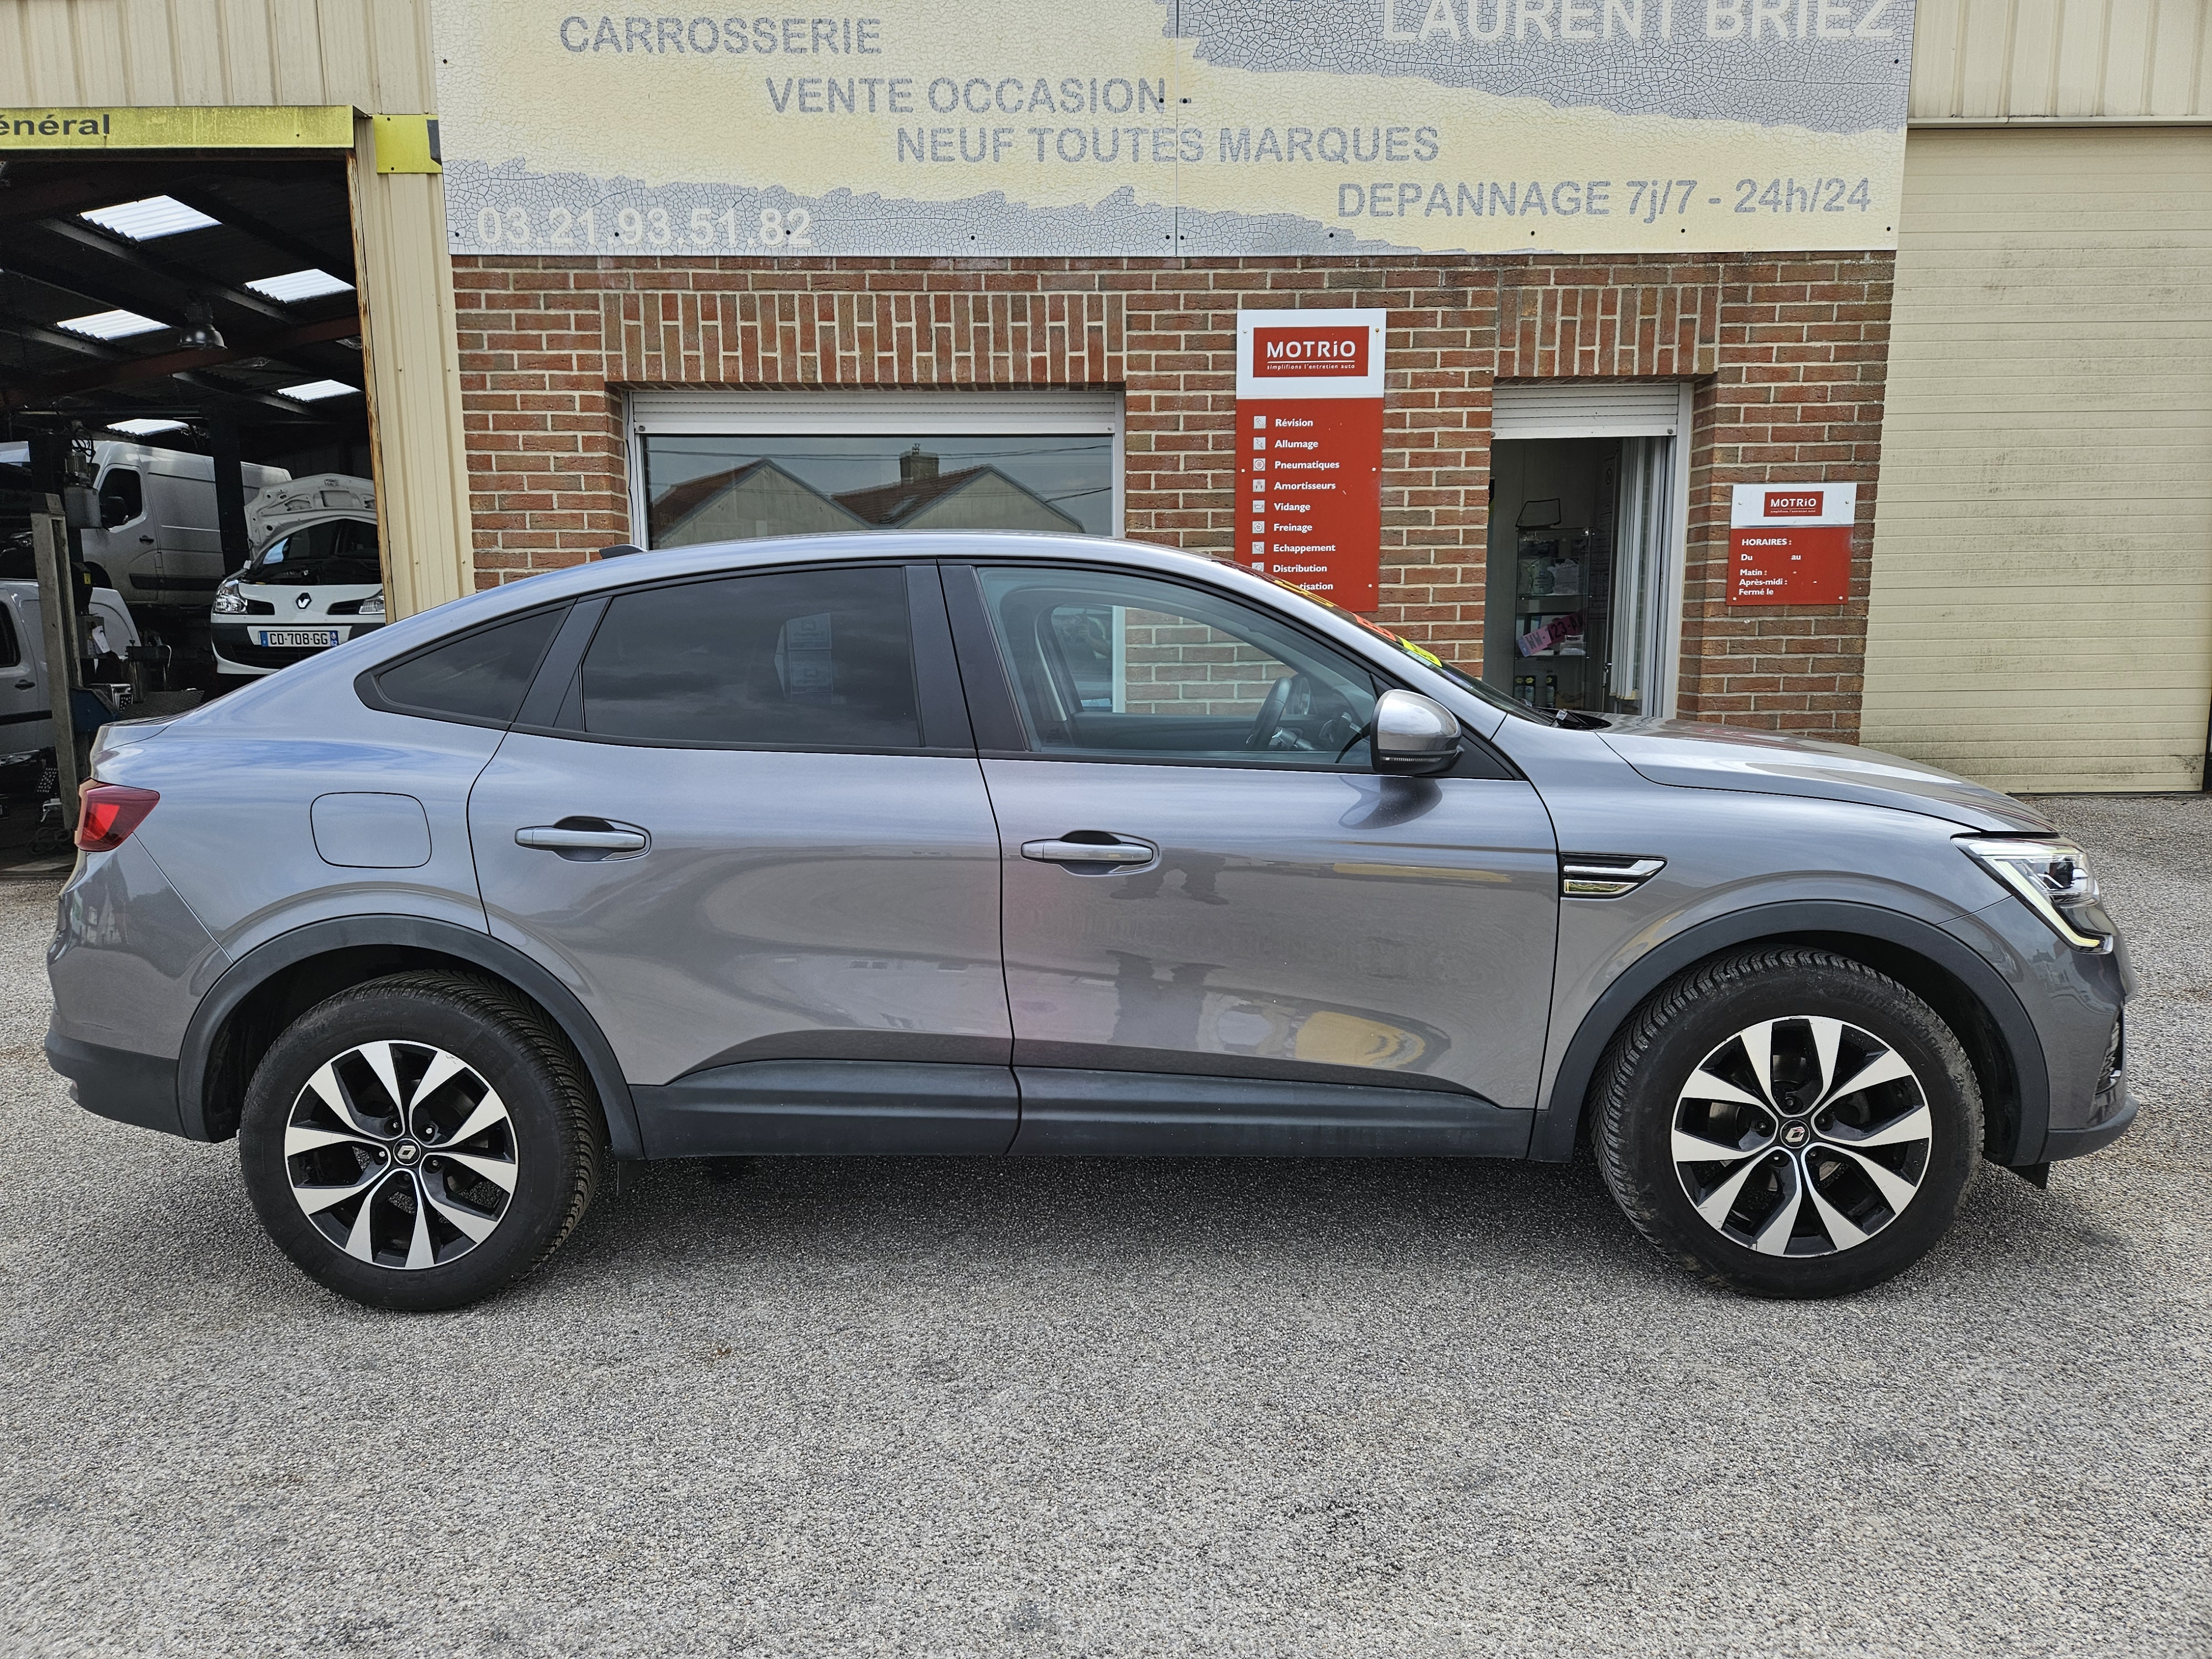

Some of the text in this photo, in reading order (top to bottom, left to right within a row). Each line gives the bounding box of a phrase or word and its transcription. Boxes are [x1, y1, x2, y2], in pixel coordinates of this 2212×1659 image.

[1705, 0, 1896, 40] BRIEZ
[559, 15, 883, 54] CARROSSERIE
[765, 77, 1165, 114] VENTE OCCASION
[897, 126, 1439, 164] NEUF TOUTES MARQUES
[1338, 180, 1611, 217] DEPANNAGE
[1625, 179, 1698, 224] 7j/7
[1734, 177, 1872, 214] 24h/24
[477, 207, 813, 247] 03.21.93.51.82
[1275, 418, 1313, 427] Révision
[1275, 440, 1318, 450] Allumage
[1275, 460, 1340, 471] Pneumatiques
[1274, 482, 1336, 491] Amortisseurs
[1274, 503, 1311, 513] Vidange
[1274, 523, 1313, 533] Freinage
[1273, 543, 1336, 554] Echappement
[1273, 564, 1327, 572] Distribution
[1296, 582, 1333, 591] tisation
[1739, 578, 1783, 587] Après-midi
[269, 633, 328, 645] CD-708-GG
